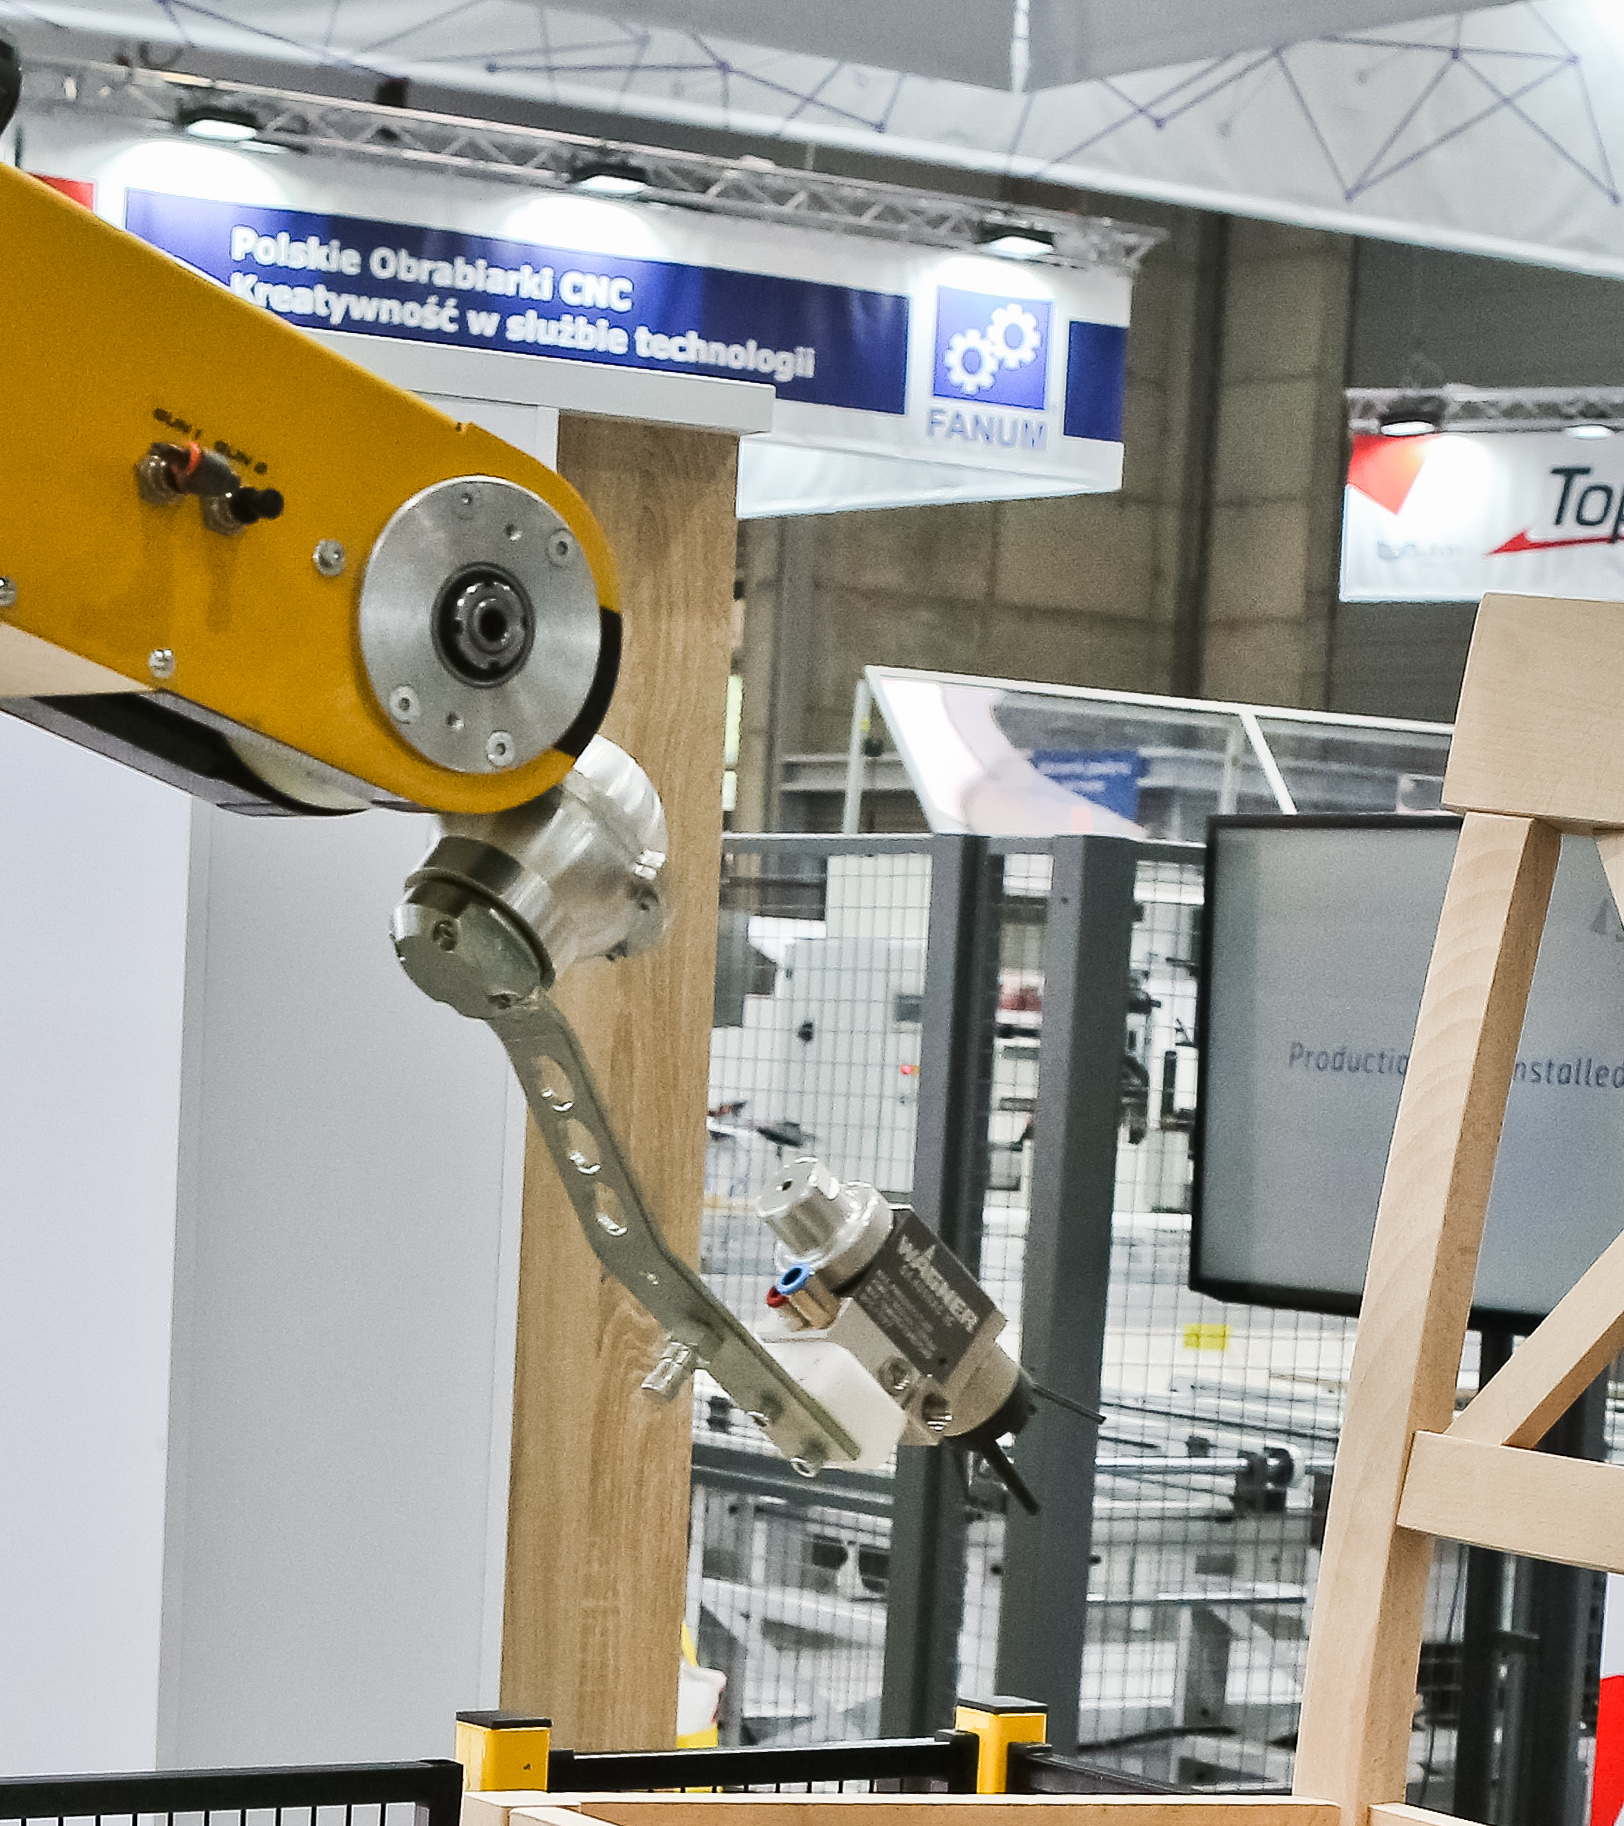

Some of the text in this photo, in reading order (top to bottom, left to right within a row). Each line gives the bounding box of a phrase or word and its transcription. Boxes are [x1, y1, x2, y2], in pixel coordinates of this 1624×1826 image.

[231, 225, 634, 313] Polskie Obrabiarki CNC
[466, 309, 501, 337] w
[634, 325, 816, 382] technologii
[928, 407, 1048, 450] FANUM
[1288, 1041, 1409, 1075] Productio
[896, 1232, 981, 1334] WAGNER
